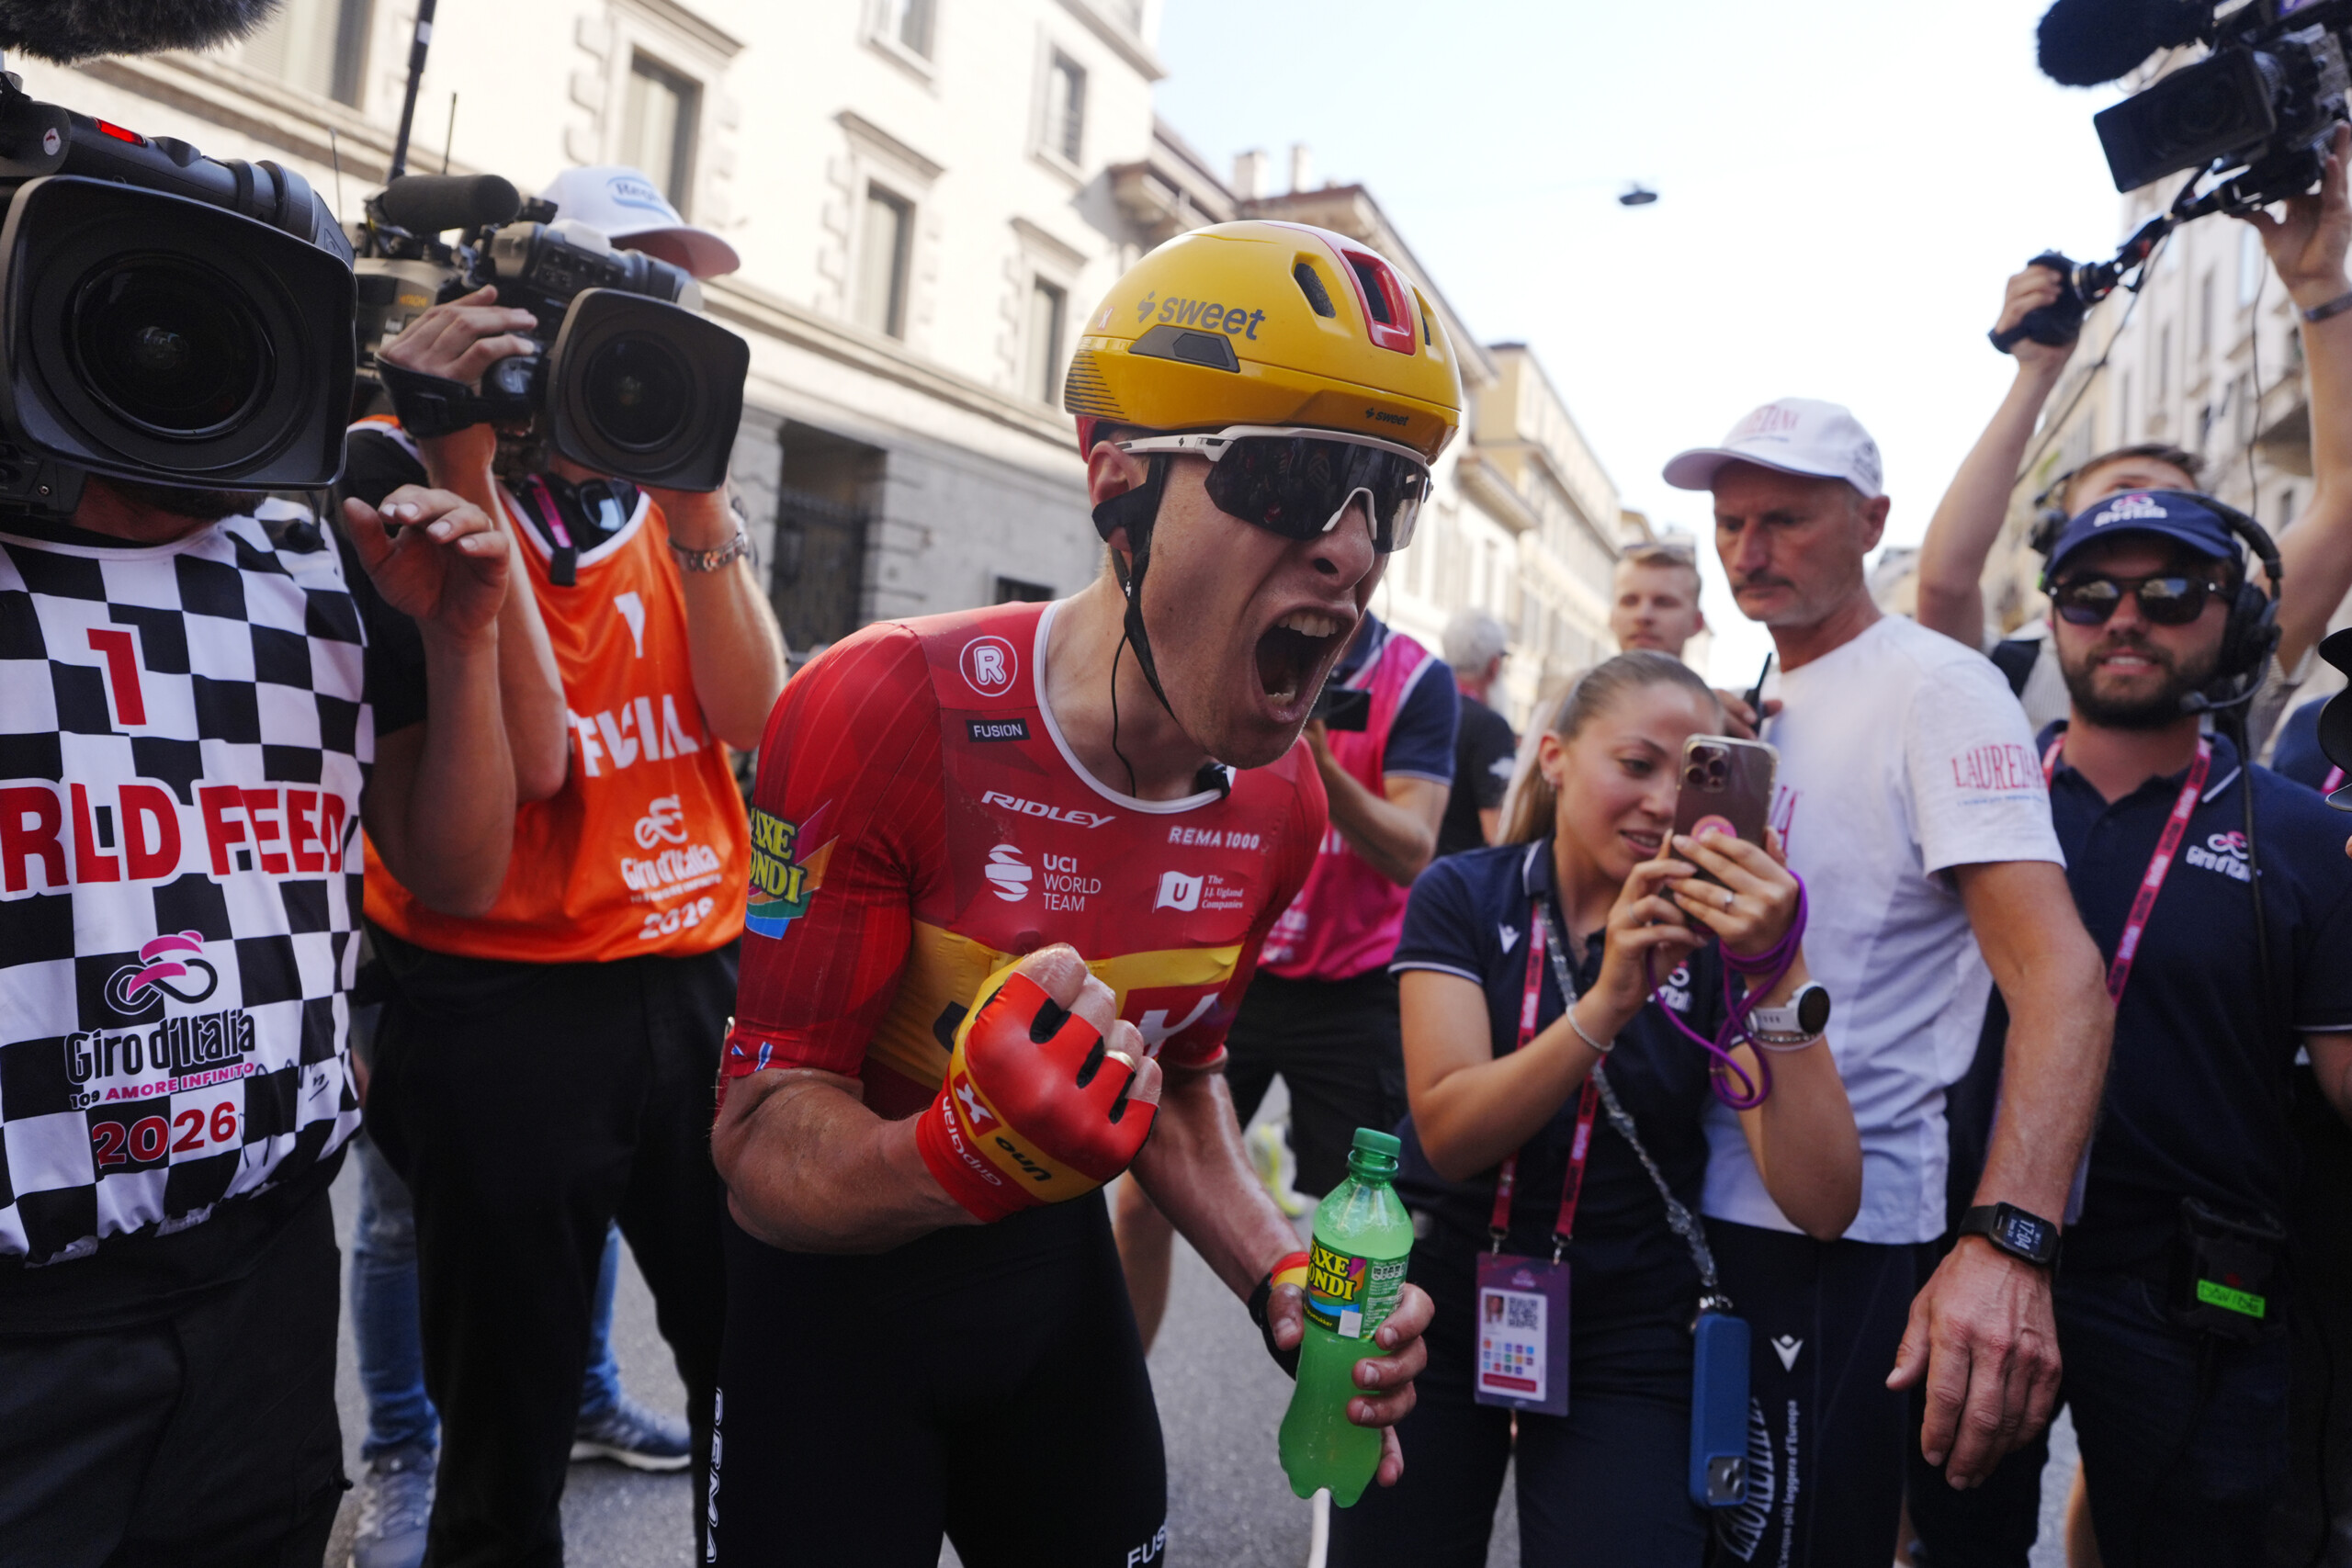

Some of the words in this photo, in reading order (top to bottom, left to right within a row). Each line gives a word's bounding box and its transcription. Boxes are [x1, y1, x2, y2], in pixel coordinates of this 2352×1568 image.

[1158, 297, 1265, 341] sweet
[1375, 412, 1409, 426] sweet
[86, 628, 147, 726] 1
[973, 724, 1023, 738] FUSION
[981, 790, 1116, 829] RIDLEY
[0, 783, 181, 892] RLD
[198, 784, 345, 875] FEED
[751, 807, 796, 860] AXE
[1168, 825, 1222, 847] REMA
[1226, 830, 1261, 850] 1000
[1043, 853, 1077, 873] UCI
[1207, 874, 1224, 885] The
[1043, 873, 1102, 895] WORLD
[1043, 893, 1085, 911] TEAM
[1173, 883, 1189, 902] U
[1202, 899, 1243, 910] Companies
[65, 1027, 142, 1086] Giro
[149, 1009, 255, 1070] d'Italia
[70, 1090, 100, 1110] 109
[105, 1078, 177, 1101] AMORE
[183, 1063, 254, 1089] INFINITO
[92, 1101, 236, 1166] 2026
[996, 1136, 1052, 1183] Uno
[2014, 1220, 2035, 1250] 17:04
[1309, 1263, 1355, 1301] ONDI
[1127, 1525, 1166, 1568] FUS
